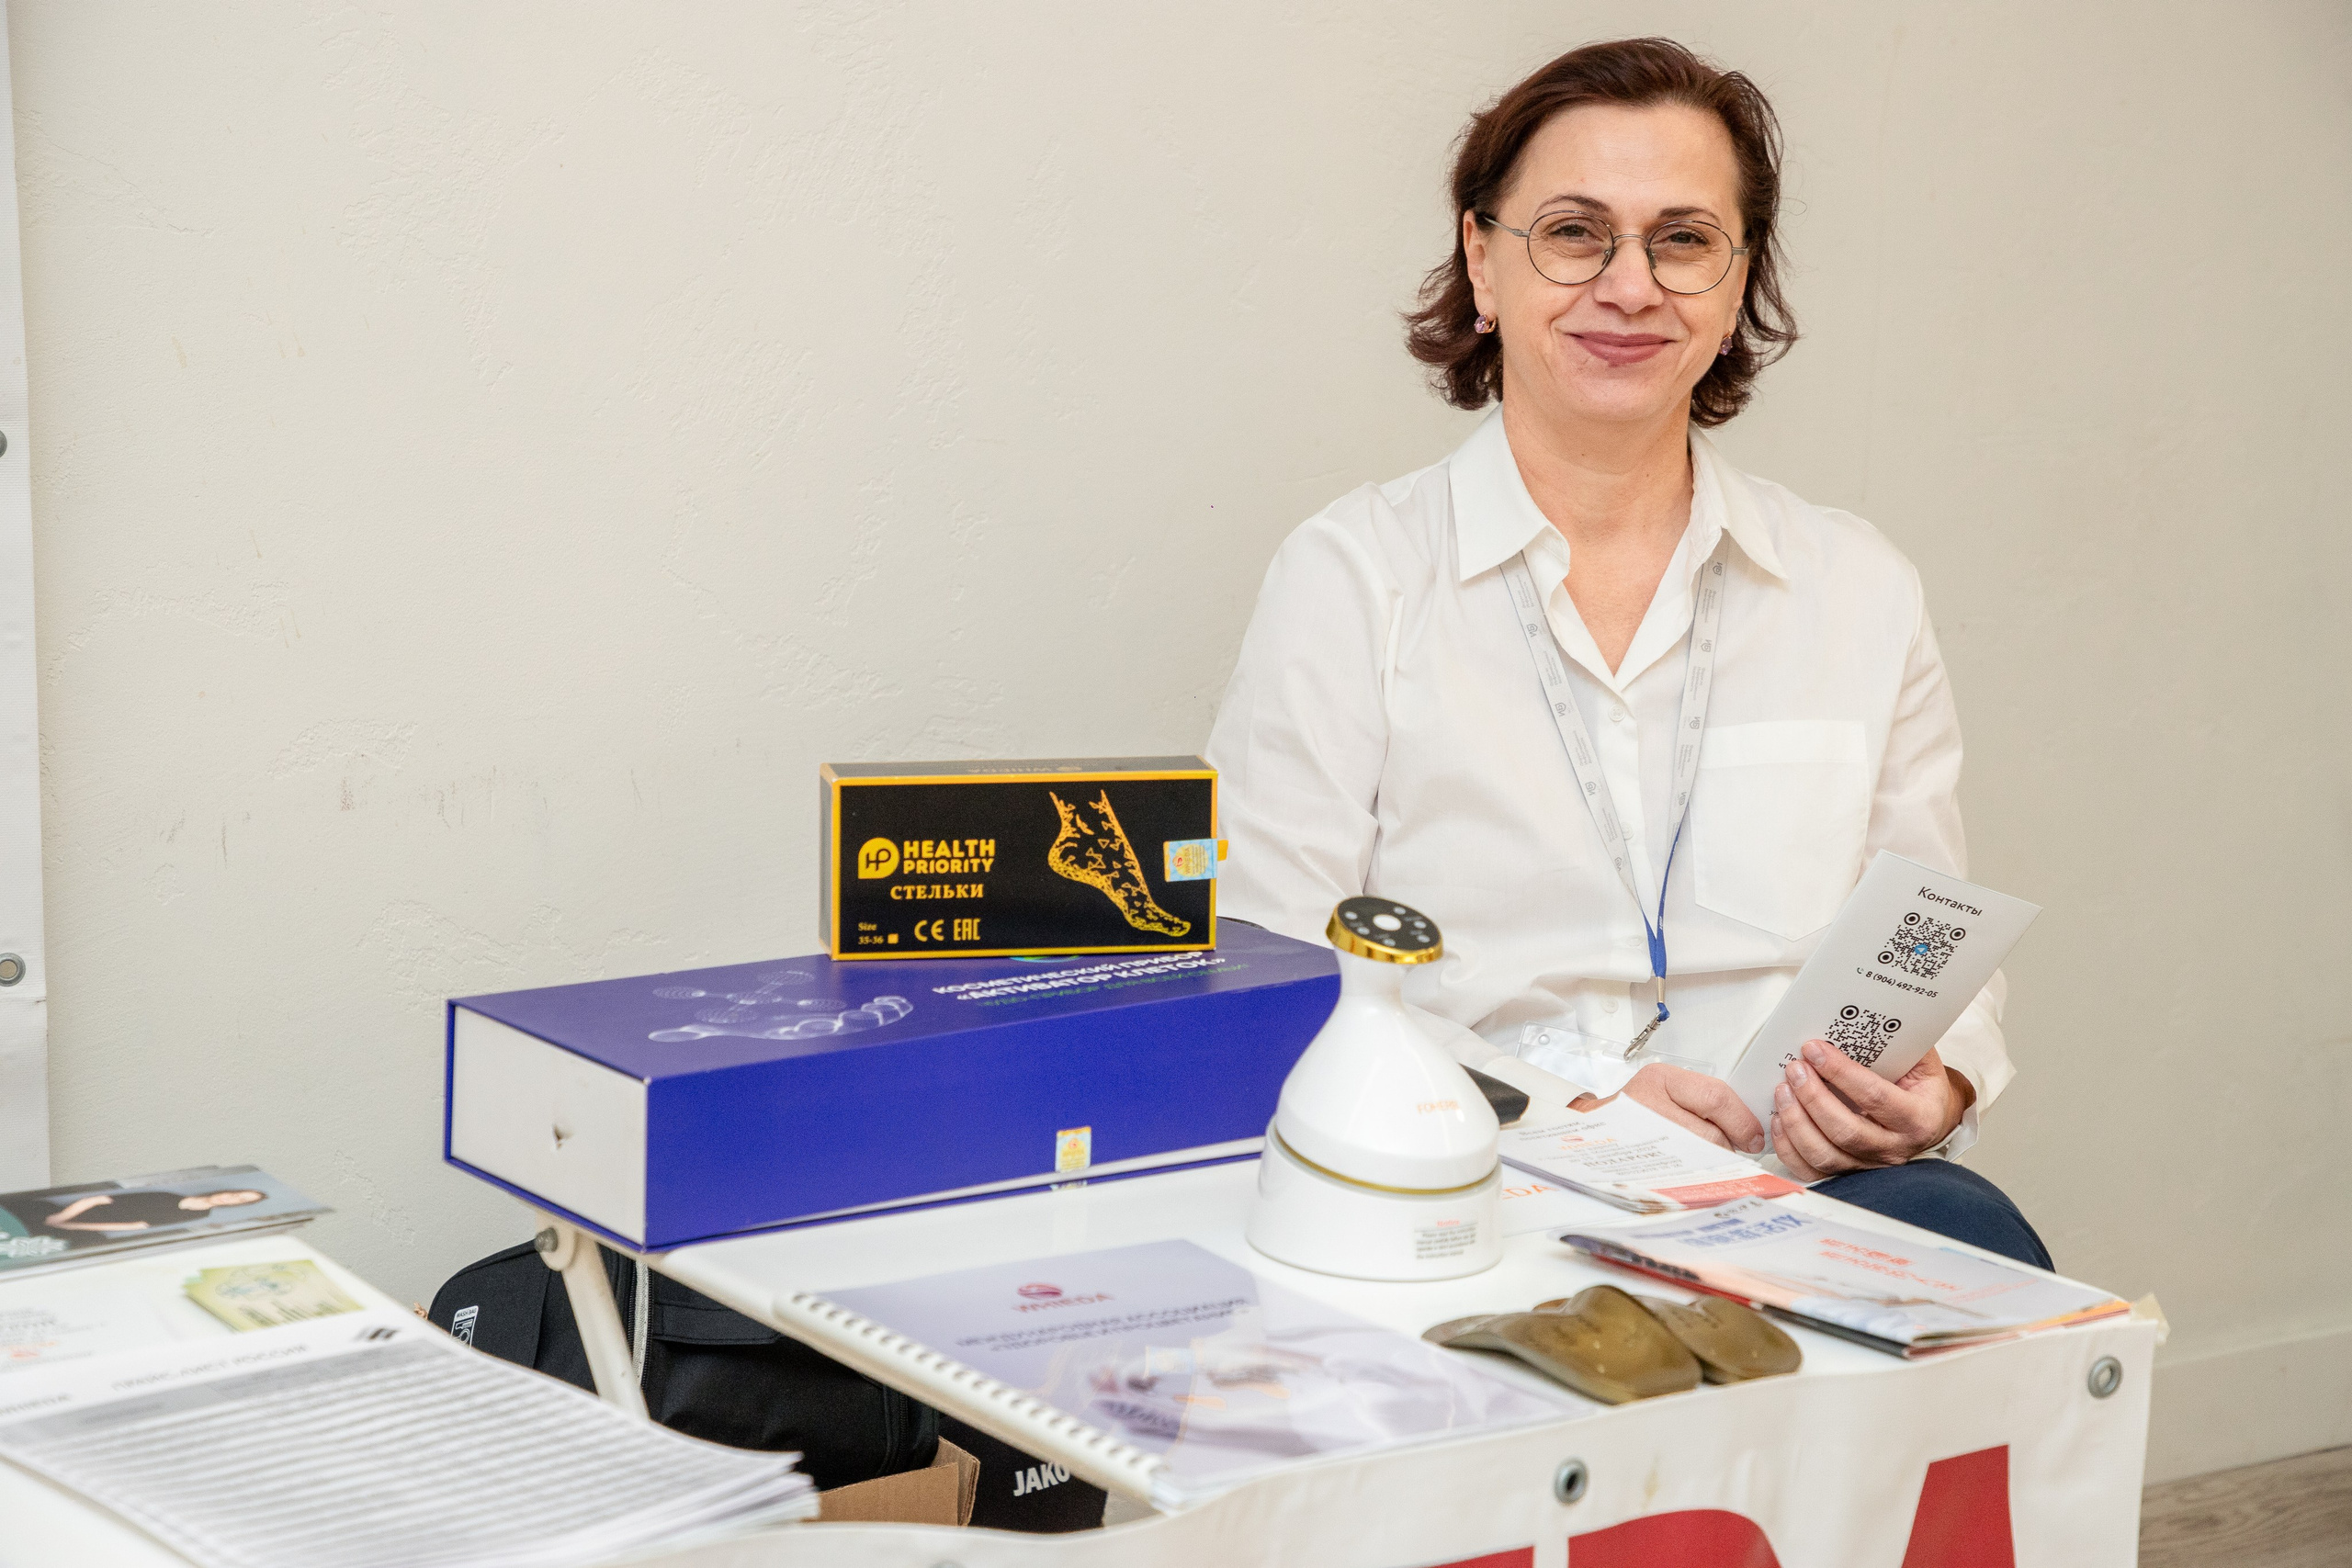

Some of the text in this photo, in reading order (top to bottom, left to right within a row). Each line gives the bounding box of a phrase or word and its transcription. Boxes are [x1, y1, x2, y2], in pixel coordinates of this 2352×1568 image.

[903, 839, 995, 859] HEALTH
[903, 858, 995, 874] PRIORITY
[889, 884, 984, 900] СТЕЛЬКИ
[1917, 886, 1983, 917] Контакты
[858, 922, 877, 931] Size
[932, 964, 1118, 994] КОСМЕТИЧЕСКИЙ
[1118, 951, 1203, 969] ПРИБОР
[1865, 970, 1939, 998] 8 (904) 492-92-05
[1013, 1460, 1070, 1496] JAKO
